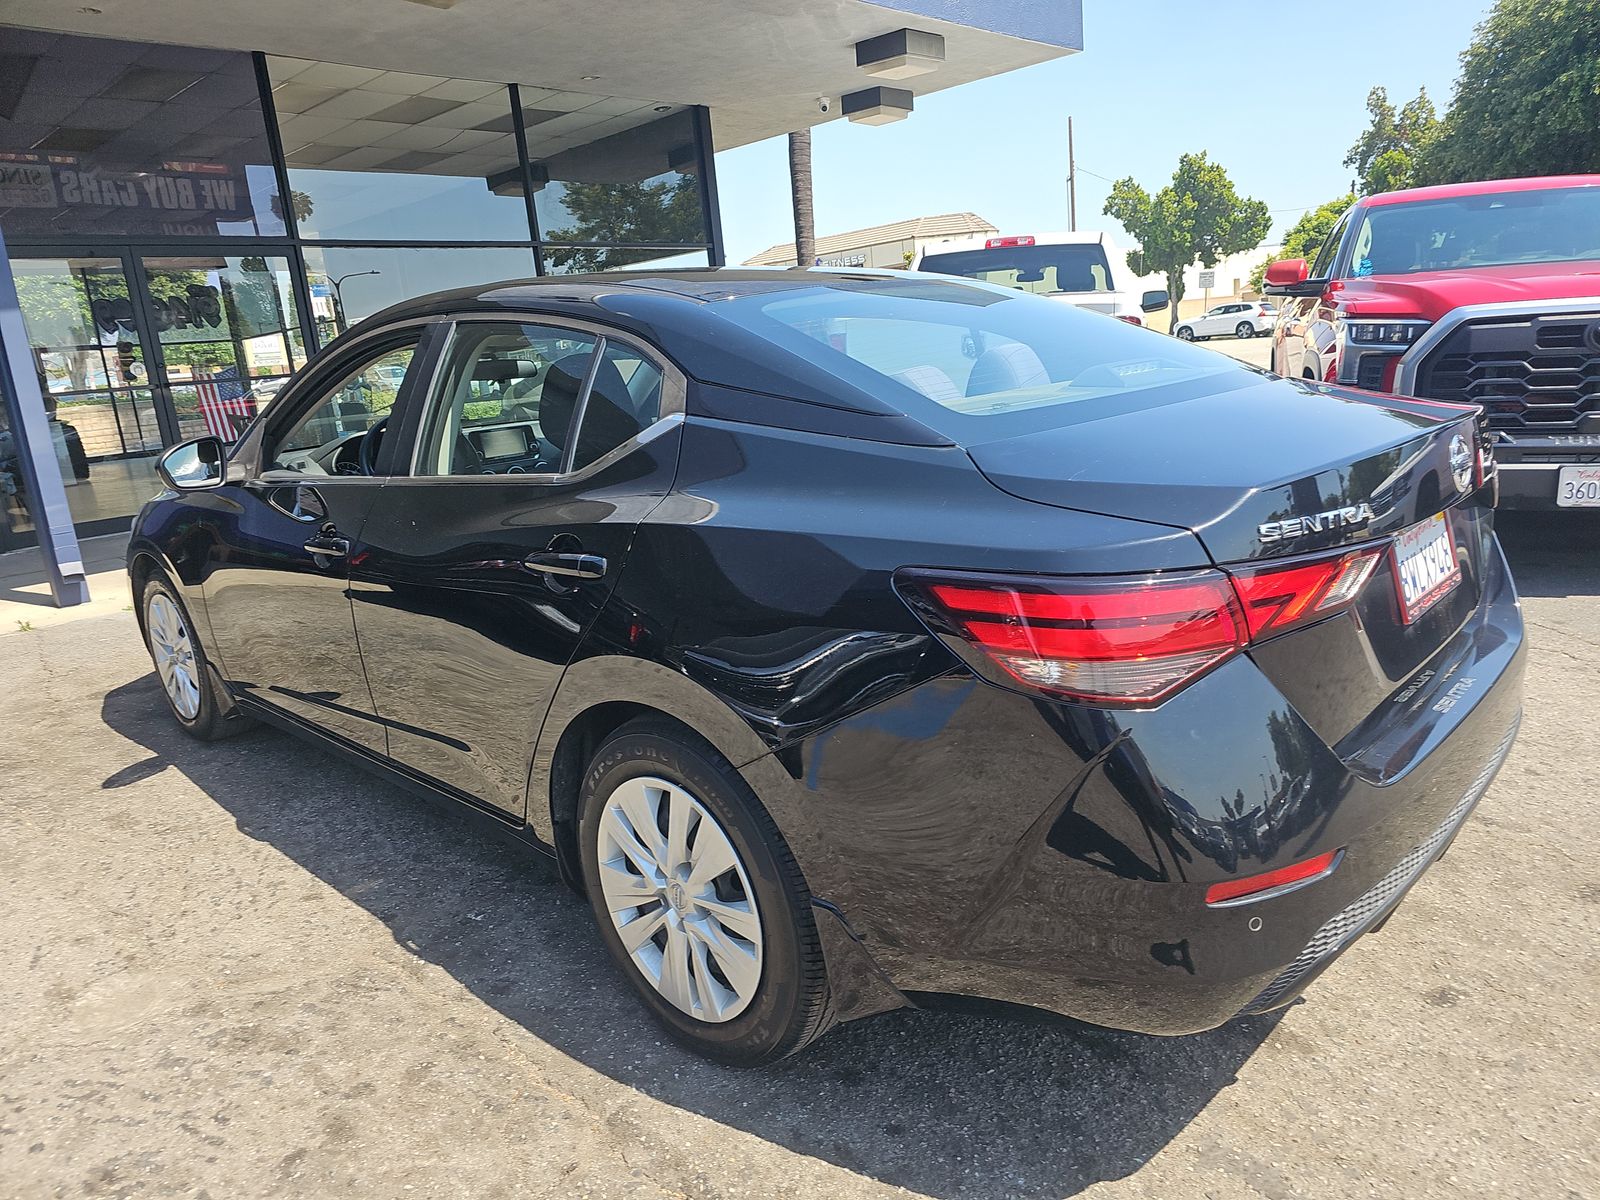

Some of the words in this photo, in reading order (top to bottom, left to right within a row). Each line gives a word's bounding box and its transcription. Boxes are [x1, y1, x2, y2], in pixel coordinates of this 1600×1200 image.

[822, 254, 866, 267] FITNESS
[1564, 482, 1600, 499] 360
[1257, 503, 1376, 542] SENTRA
[1432, 677, 1477, 714] SENTRA
[588, 745, 669, 790] Firesone
